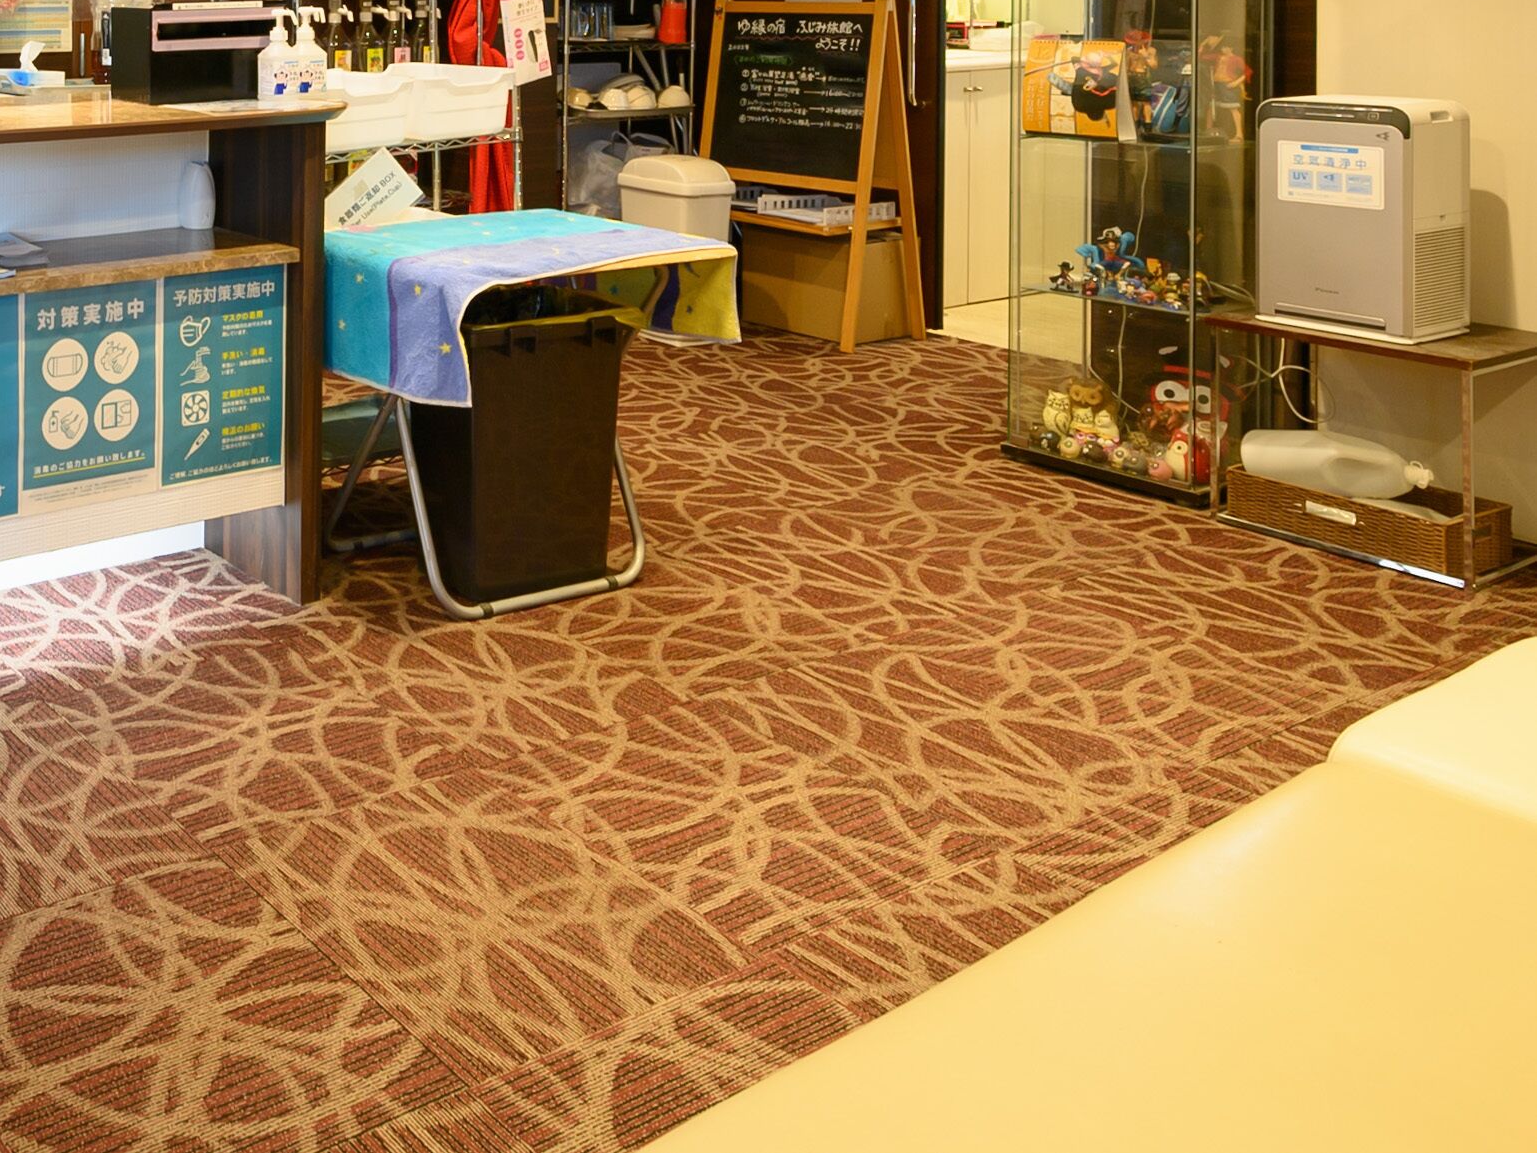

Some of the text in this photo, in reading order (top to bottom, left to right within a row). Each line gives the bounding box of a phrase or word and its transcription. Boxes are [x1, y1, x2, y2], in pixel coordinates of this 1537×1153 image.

[796, 19, 863, 35] ふじみ旅館へ
[173, 280, 276, 307] 予防対策実施中
[37, 297, 146, 331] 対策実施中
[222, 346, 266, 360] 手洗い・消毒
[222, 385, 266, 400] 定期的な換気
[33, 449, 146, 475] 消毒のご協力をお願い致します。
